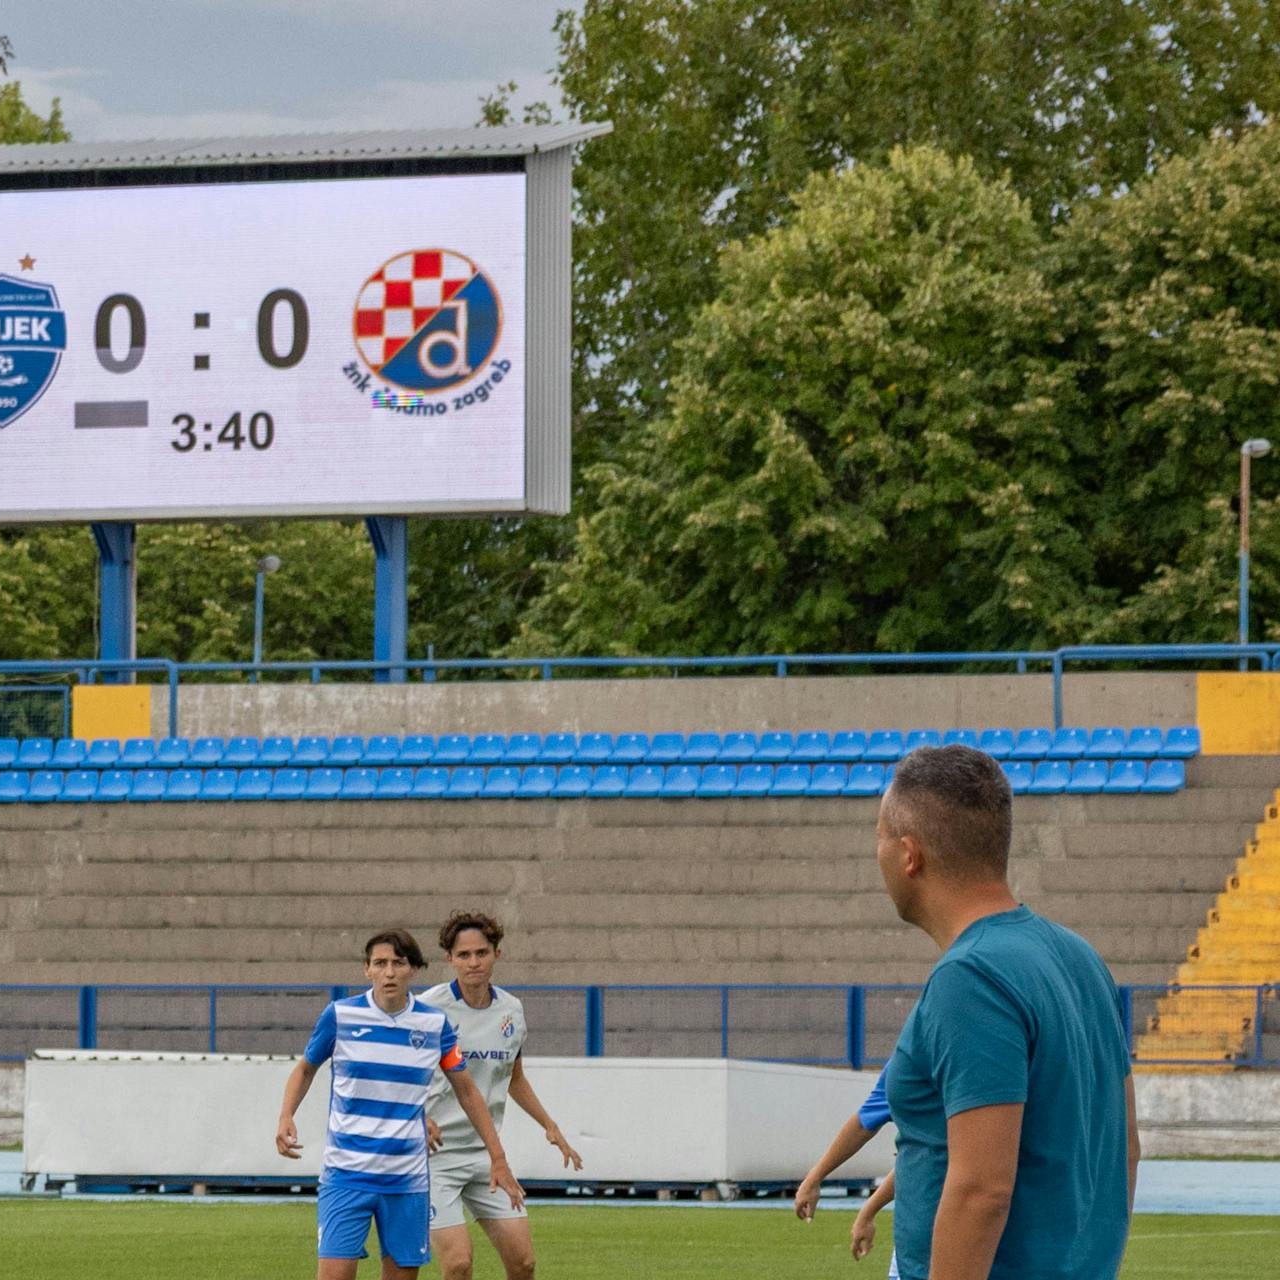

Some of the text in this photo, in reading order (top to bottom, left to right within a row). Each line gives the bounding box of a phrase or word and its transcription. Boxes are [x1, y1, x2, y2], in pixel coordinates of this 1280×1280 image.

[95, 292, 147, 373] 0
[256, 287, 310, 368] 0
[452, 359, 512, 410] zagreb
[171, 411, 274, 452] 3:40
